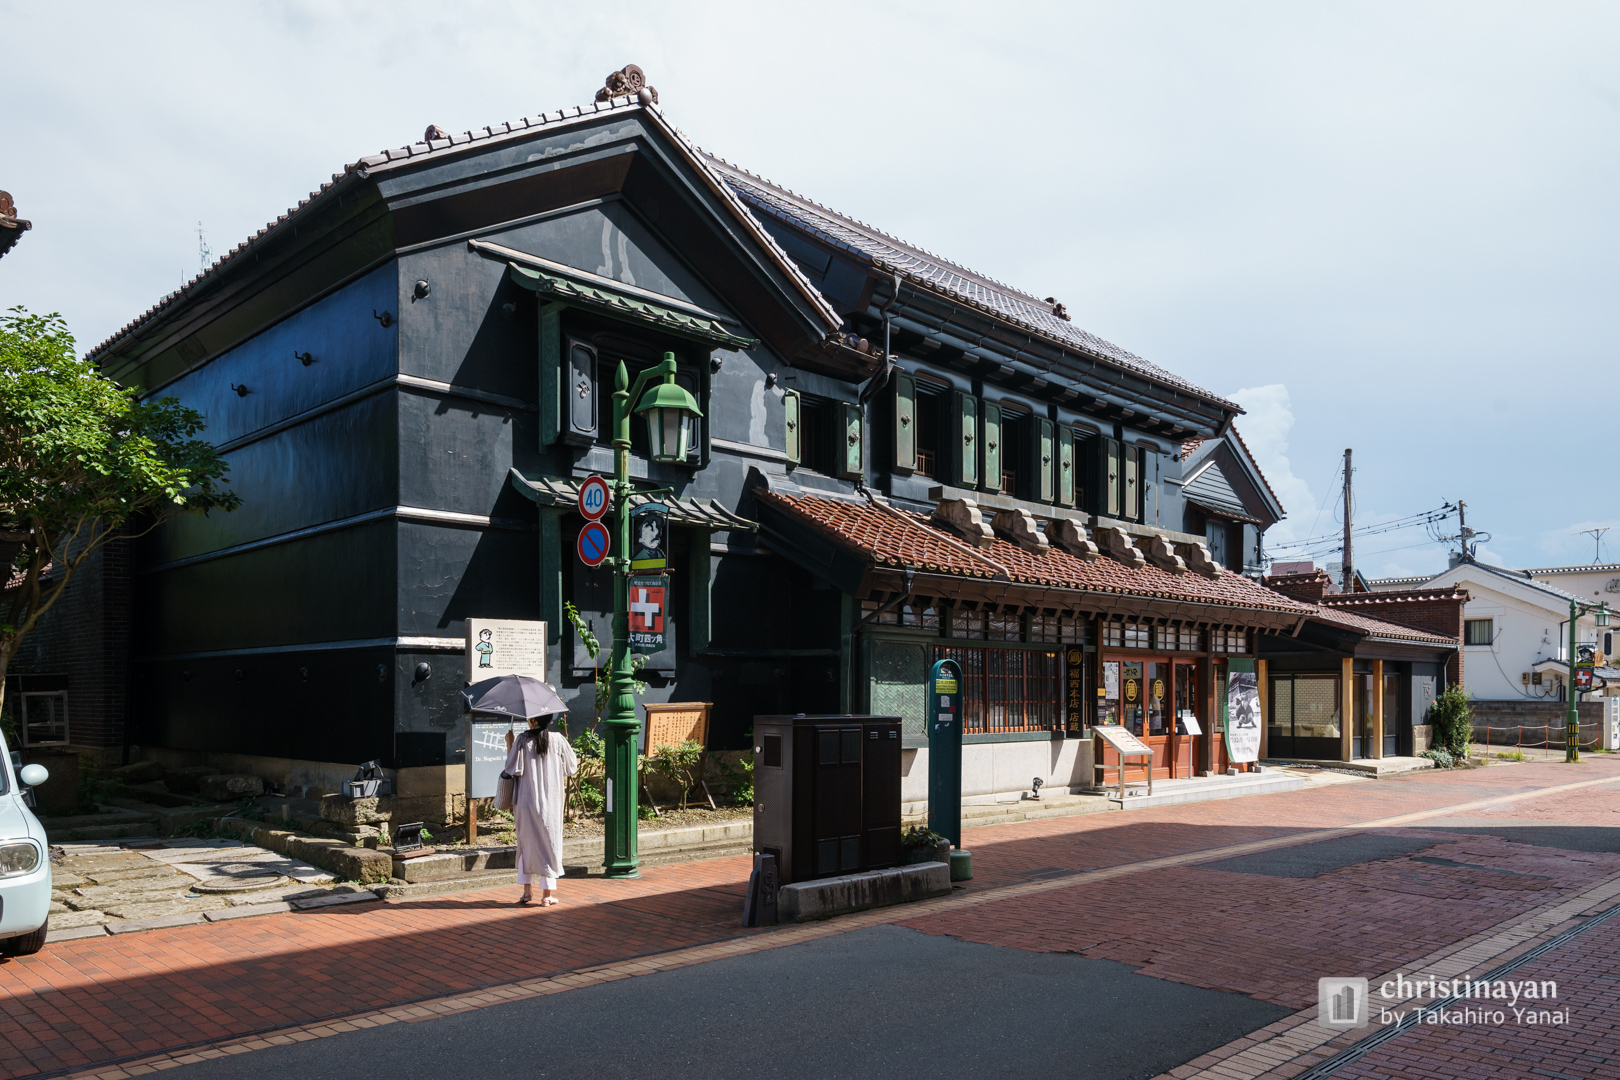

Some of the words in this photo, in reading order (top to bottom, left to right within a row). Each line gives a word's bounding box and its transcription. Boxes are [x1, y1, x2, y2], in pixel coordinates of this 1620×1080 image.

[585, 488, 603, 508] 40
[1069, 668, 1080, 709] 福西本店
